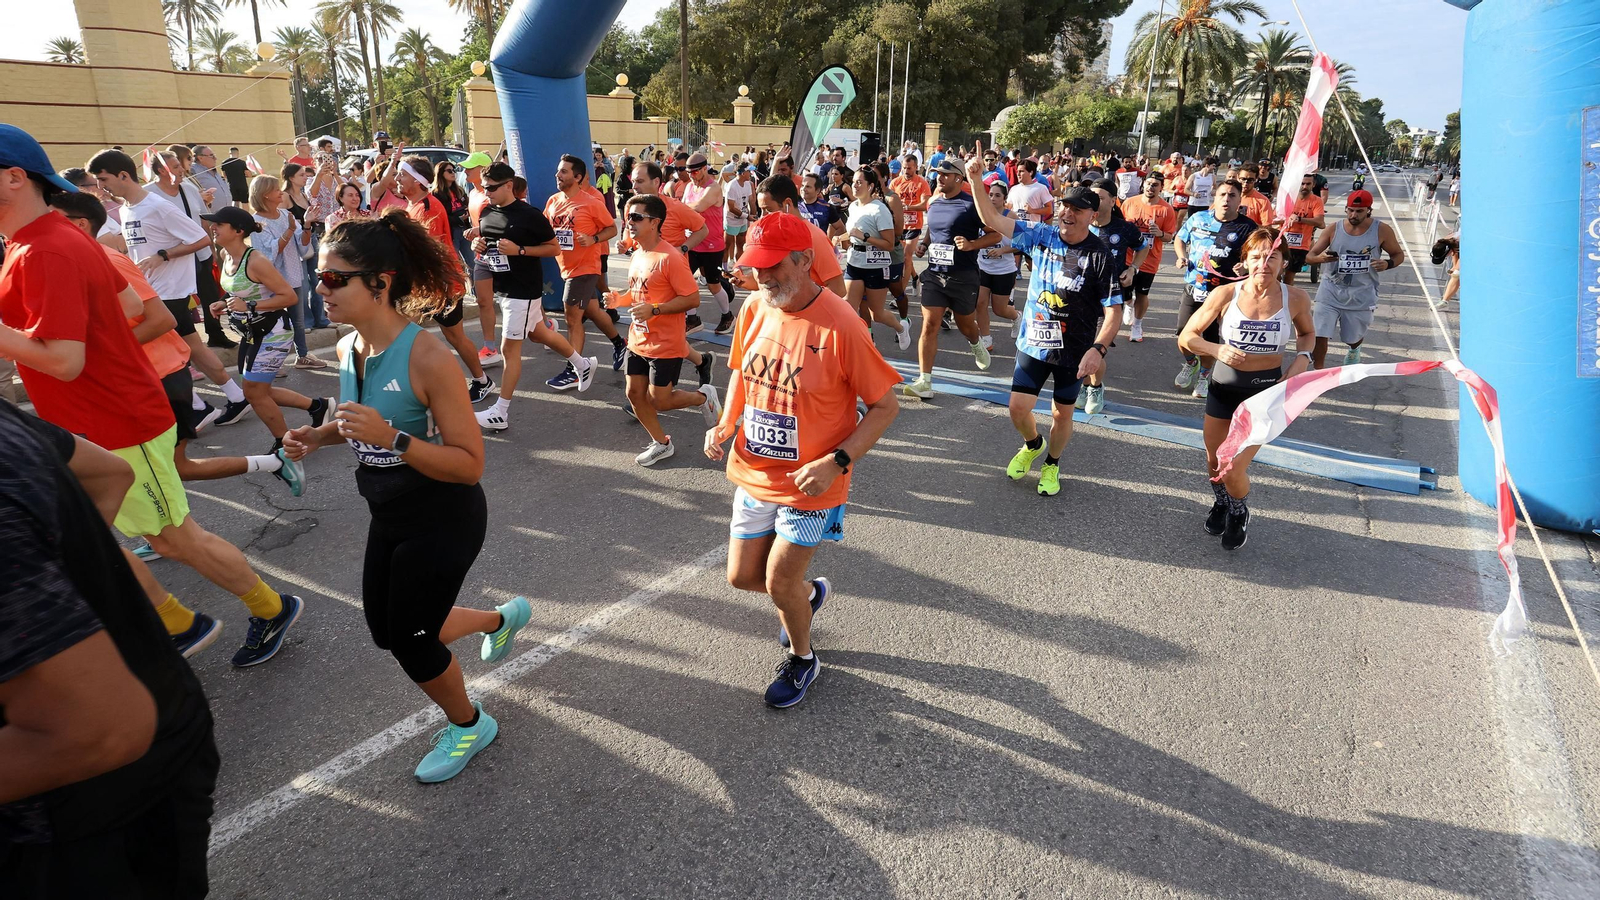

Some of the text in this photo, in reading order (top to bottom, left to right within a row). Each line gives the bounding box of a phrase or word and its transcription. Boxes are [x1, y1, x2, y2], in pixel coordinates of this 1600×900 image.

[814, 104, 841, 112] SPORT
[934, 250, 947, 259] 995
[1034, 329, 1052, 340] 700
[1240, 330, 1267, 343] 776
[750, 423, 788, 446] 1033
[786, 506, 826, 520] NISSAN
